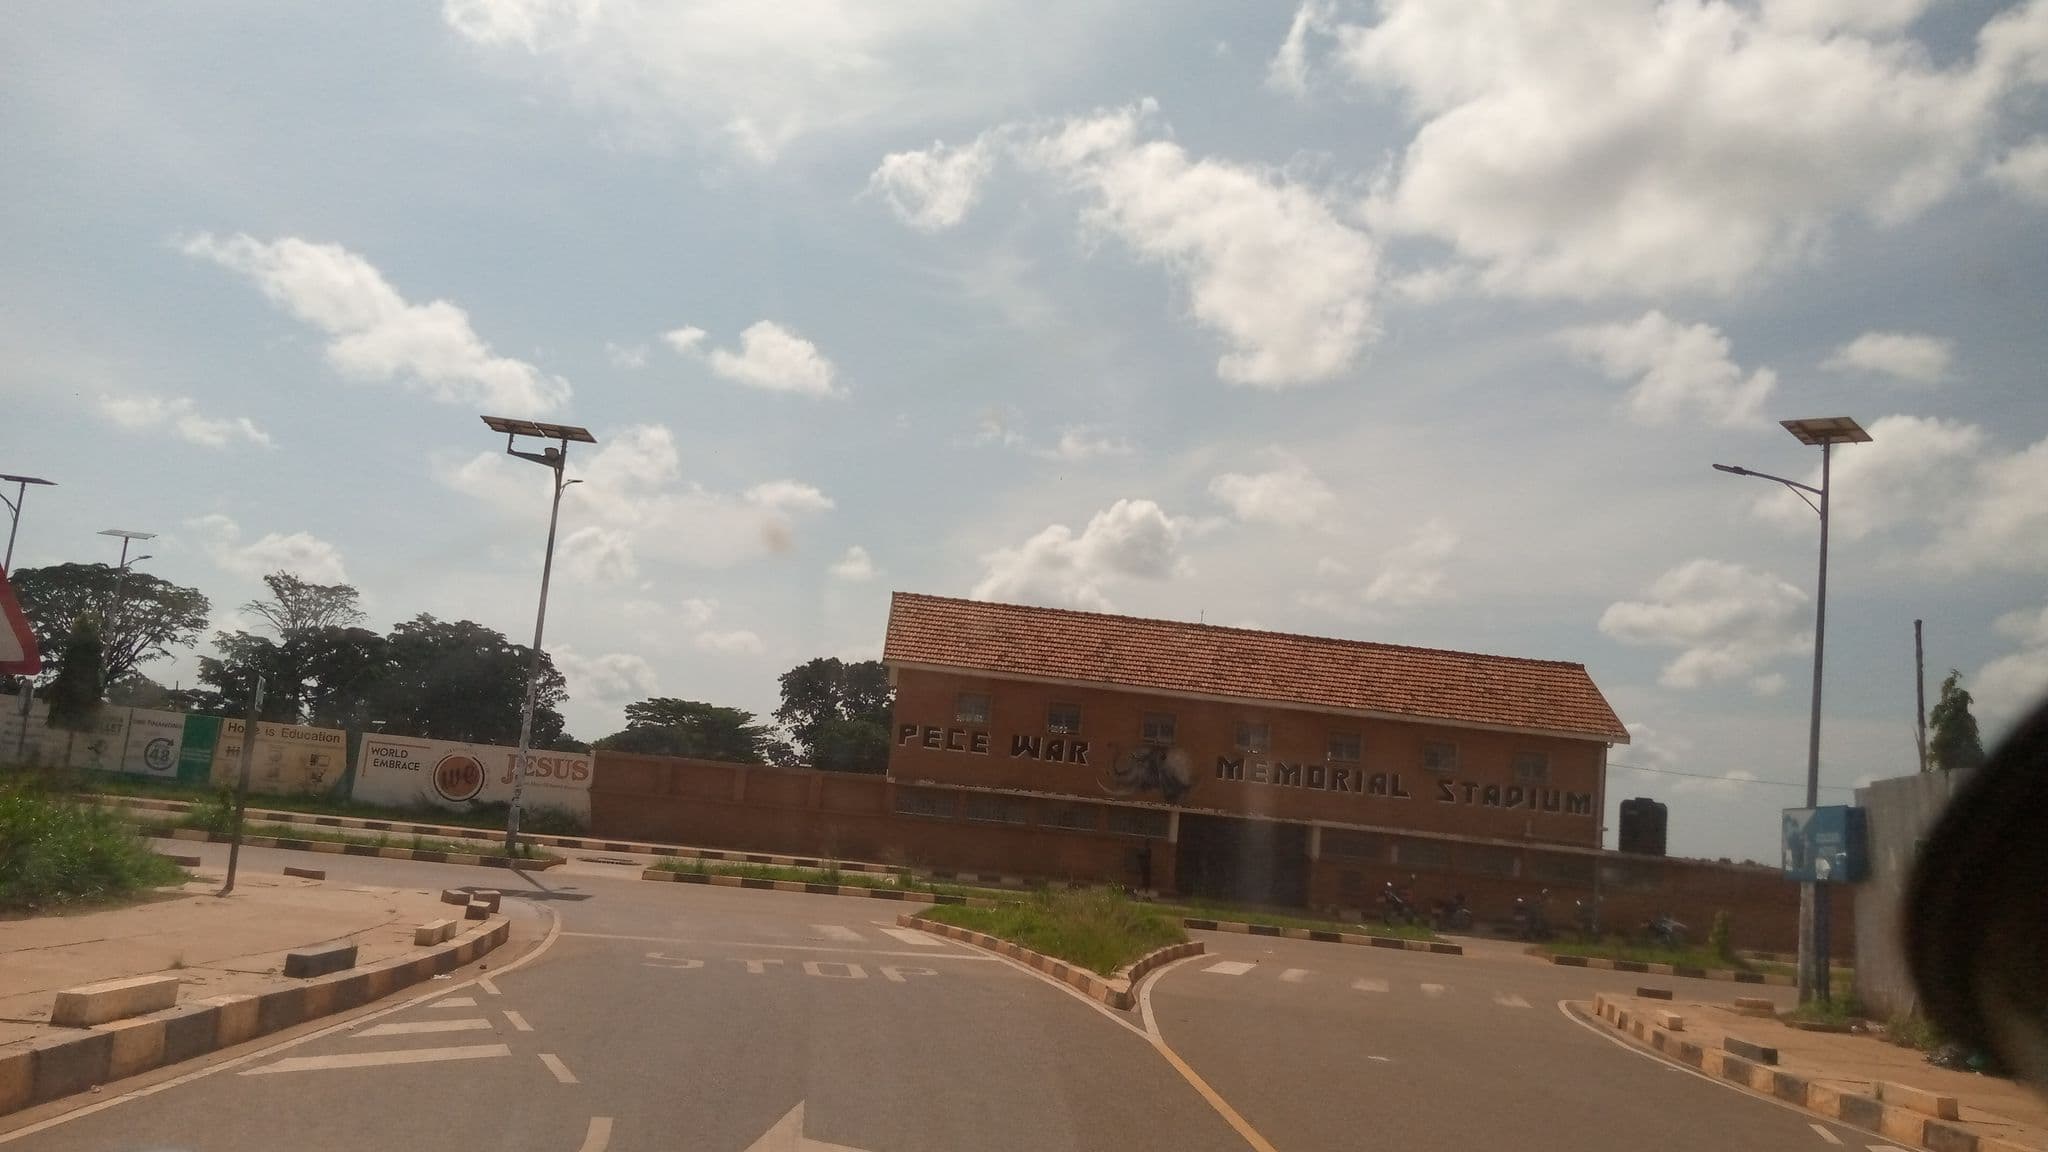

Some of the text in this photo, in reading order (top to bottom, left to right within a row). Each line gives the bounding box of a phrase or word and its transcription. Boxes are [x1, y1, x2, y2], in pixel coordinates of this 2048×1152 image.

[265, 727, 275, 737] is
[281, 727, 341, 744] Education
[371, 747, 409, 759] WORLD
[373, 758, 421, 771] EMBRACE
[501, 753, 589, 785] JESUS
[898, 723, 1592, 816] PECE WAR MEMORIAL STADIUM
[640, 951, 940, 983] STOP
